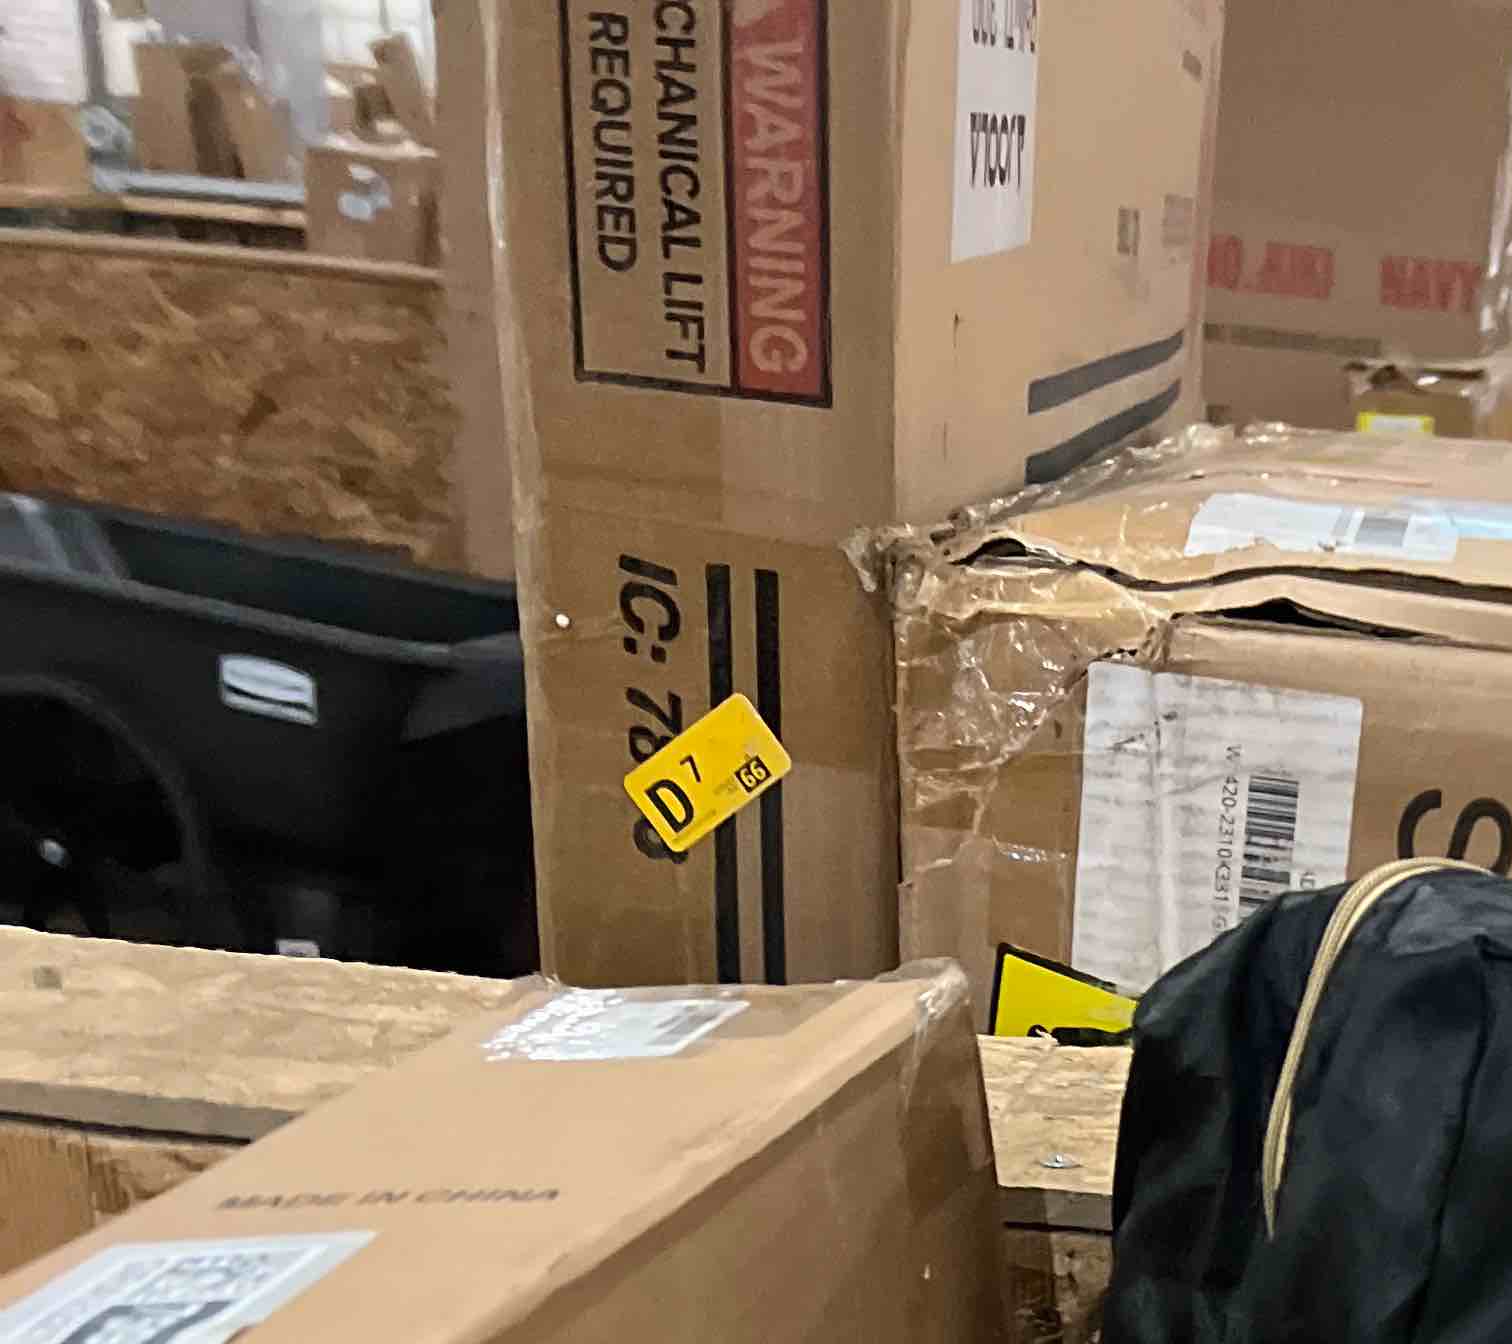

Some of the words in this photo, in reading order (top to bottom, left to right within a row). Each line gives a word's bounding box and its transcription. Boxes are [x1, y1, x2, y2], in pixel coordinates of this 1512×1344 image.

[589, 12, 638, 272] REQUIRED
[743, 41, 808, 374] WARNING
[663, 272, 706, 375] LIFT
[619, 554, 681, 664] IC:
[645, 779, 694, 832] D
[681, 755, 703, 784] 7
[355, 1188, 410, 1208] IN
[413, 1185, 561, 1206] CHINA
